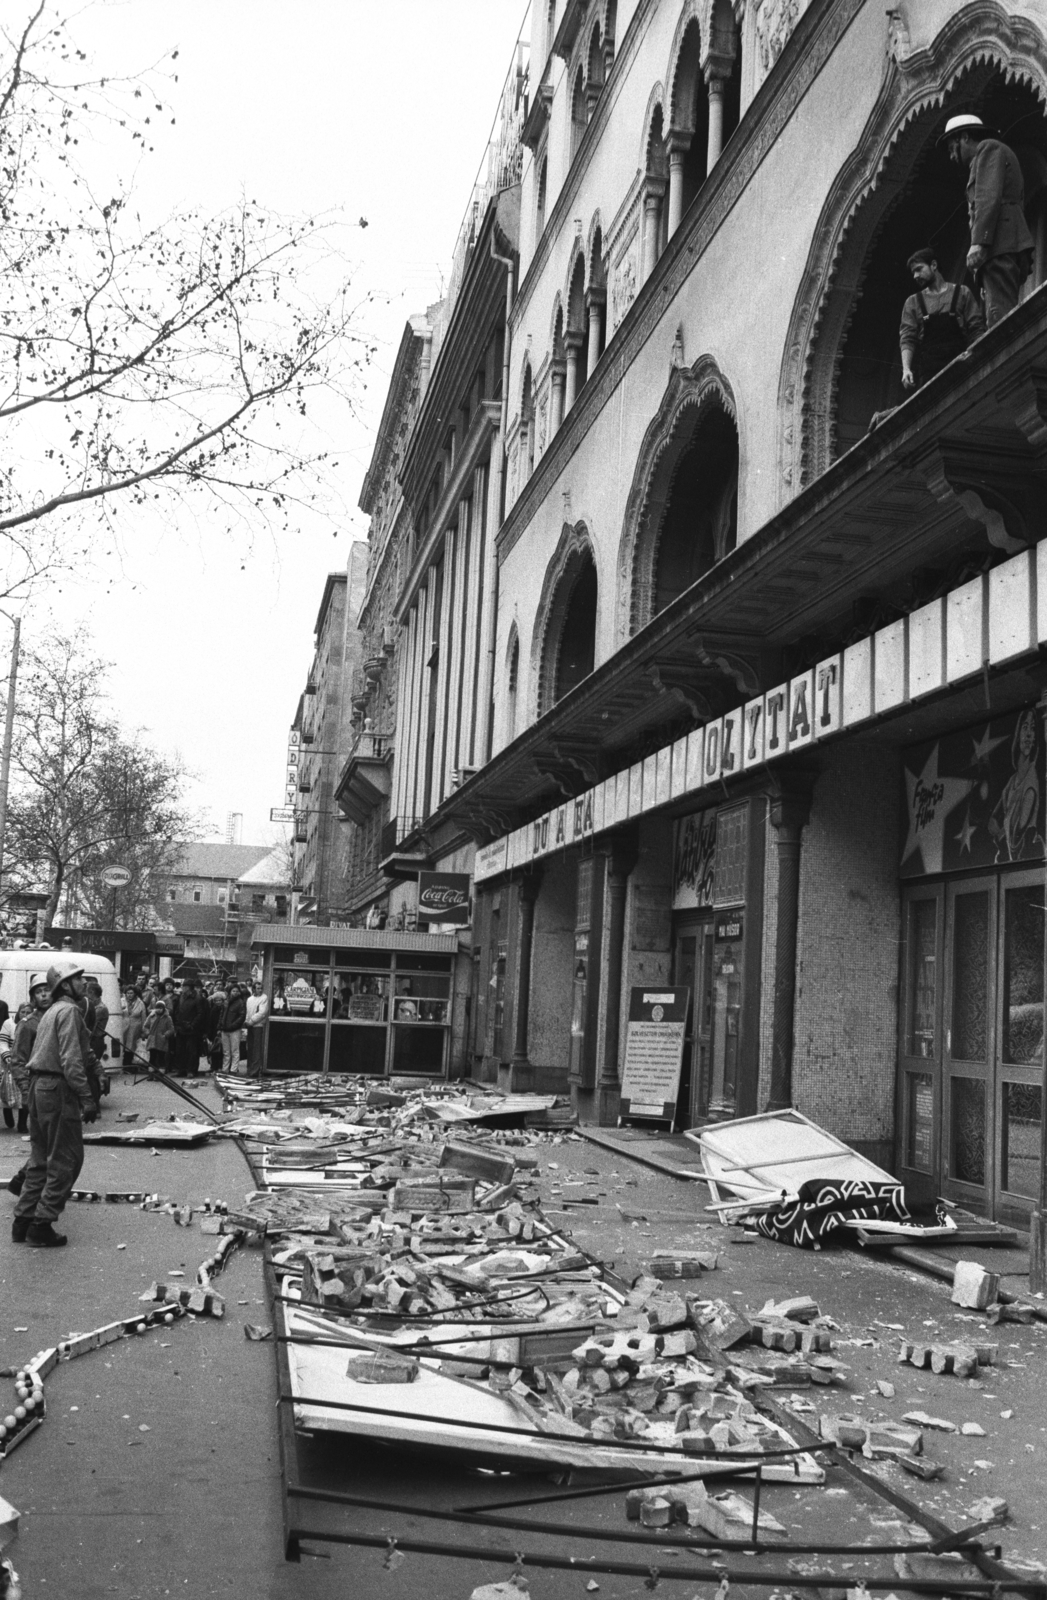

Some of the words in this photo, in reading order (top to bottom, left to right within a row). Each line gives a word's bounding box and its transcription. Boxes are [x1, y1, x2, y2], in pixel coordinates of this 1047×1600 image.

[705, 664, 838, 776] OLYTAT
[556, 809, 565, 843] A
[915, 803, 935, 834] film
[421, 888, 465, 903] Coca-Cola
